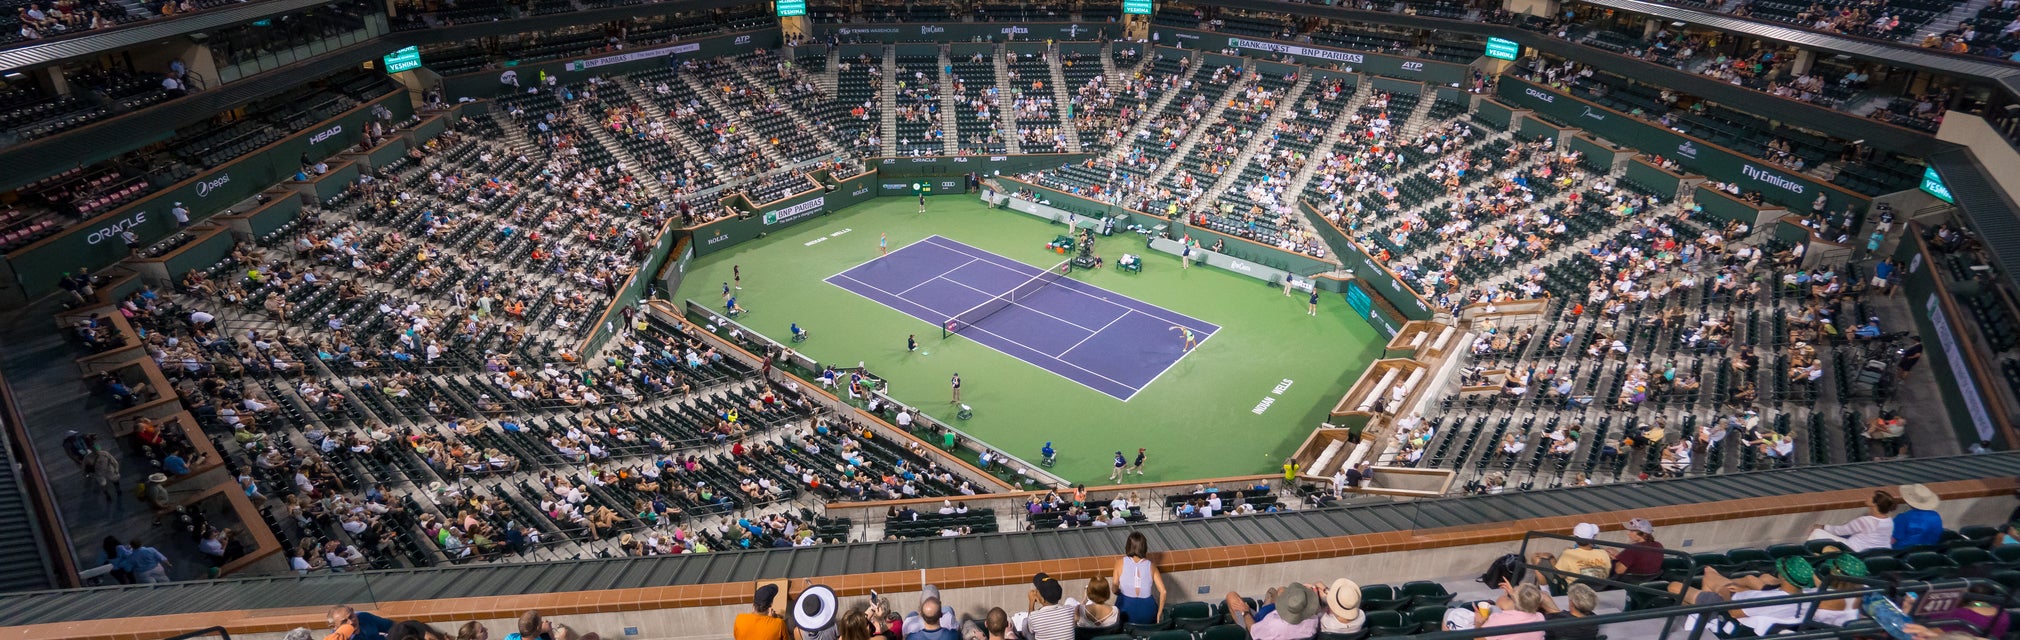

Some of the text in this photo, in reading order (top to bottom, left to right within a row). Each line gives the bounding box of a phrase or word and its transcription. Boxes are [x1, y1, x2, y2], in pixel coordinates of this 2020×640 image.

[734, 35, 751, 43] ATP
[1239, 40, 1260, 49] BANK
[585, 54, 627, 68] BNP PARIBAS
[1301, 48, 1361, 63] BNP PARIBAS
[389, 60, 418, 71] VESNINA
[1525, 88, 1554, 103] ORACLE
[309, 125, 342, 145] HEAD
[208, 173, 230, 192] pepsi
[1742, 164, 1805, 194] Fly Emirates
[852, 187, 869, 197] ROLEX
[778, 198, 822, 218] BNP PARIBAS
[87, 211, 147, 245] ORACLE
[830, 228, 852, 237] WELLS
[708, 234, 729, 245] ROLEX
[1251, 378, 1293, 415] INDIAN WELLS
[1924, 599, 1953, 612] 411
